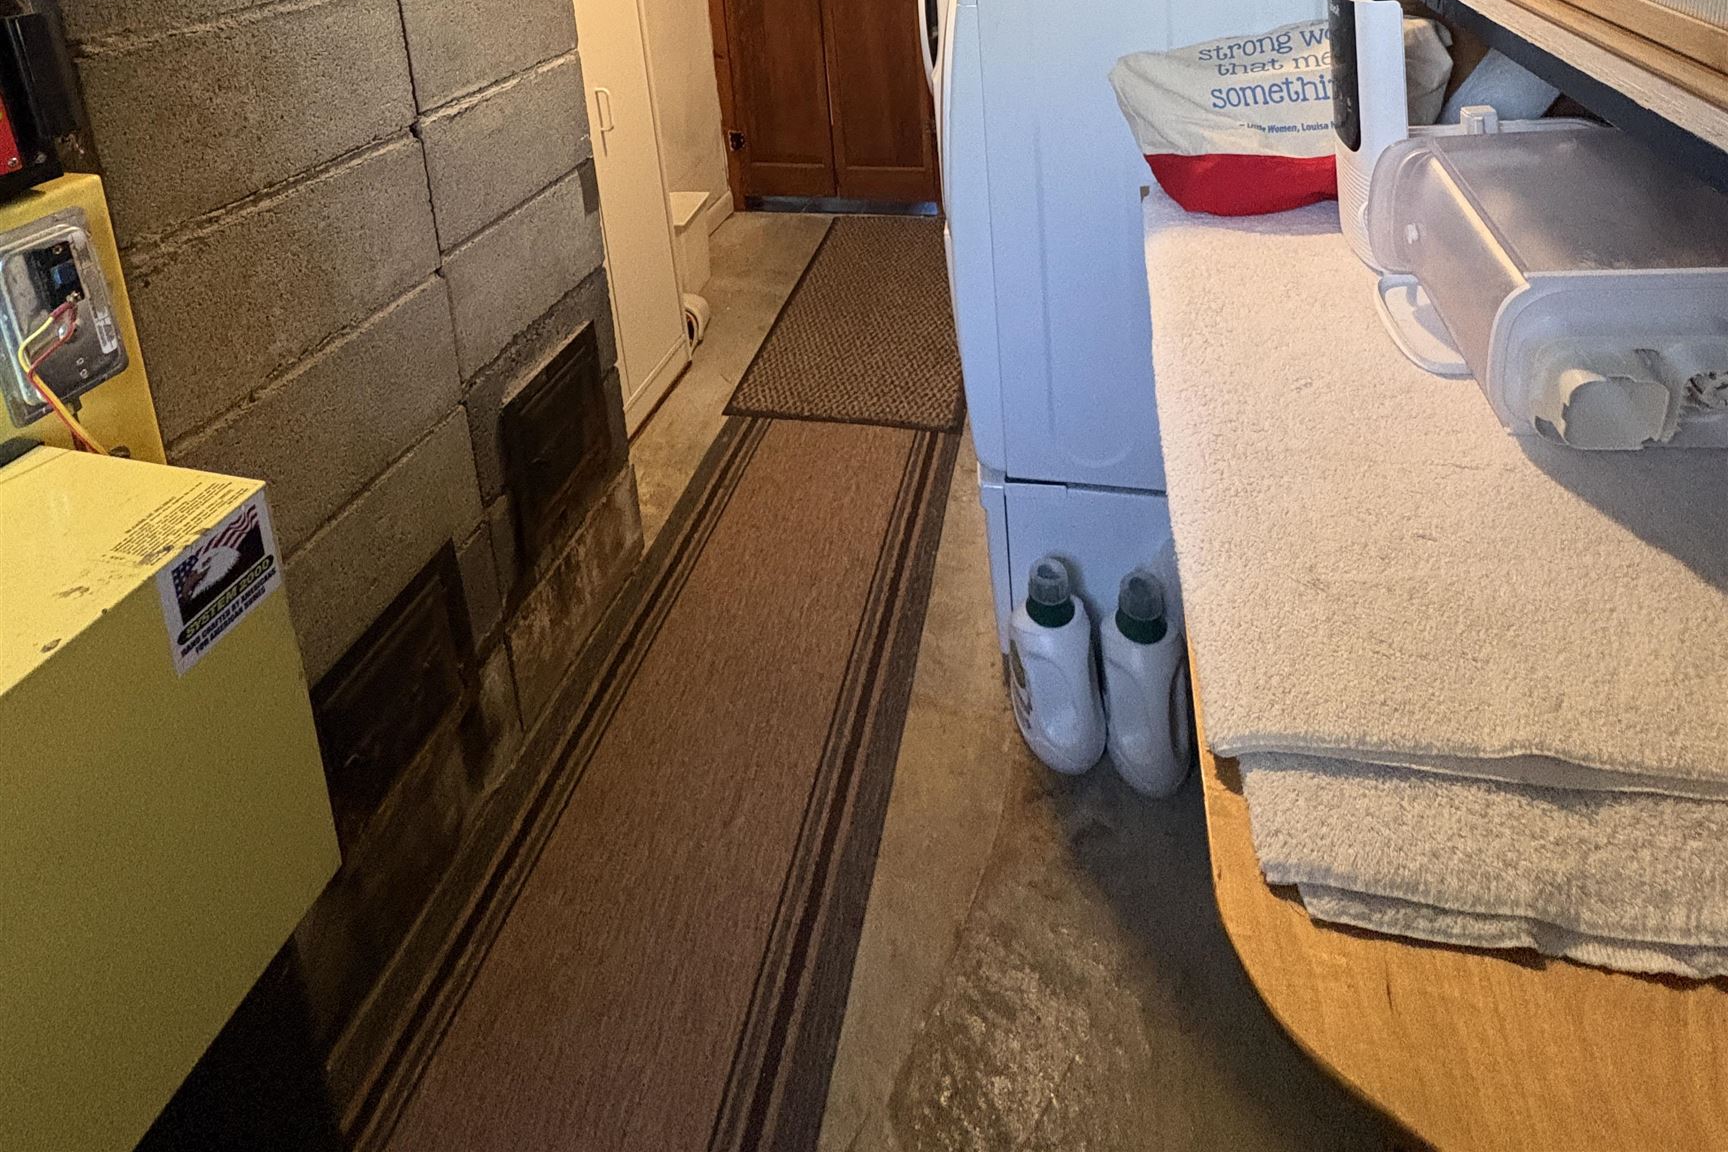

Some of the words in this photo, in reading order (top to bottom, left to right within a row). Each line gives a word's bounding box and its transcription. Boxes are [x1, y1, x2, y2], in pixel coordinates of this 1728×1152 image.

[1198, 31, 1293, 62] strong
[1217, 58, 1283, 76] that
[1210, 74, 1337, 110] somethi
[1267, 123, 1300, 134] Women,
[1301, 121, 1329, 132] Louisa
[185, 587, 238, 638] SYSTEM
[239, 558, 270, 592] 2000
